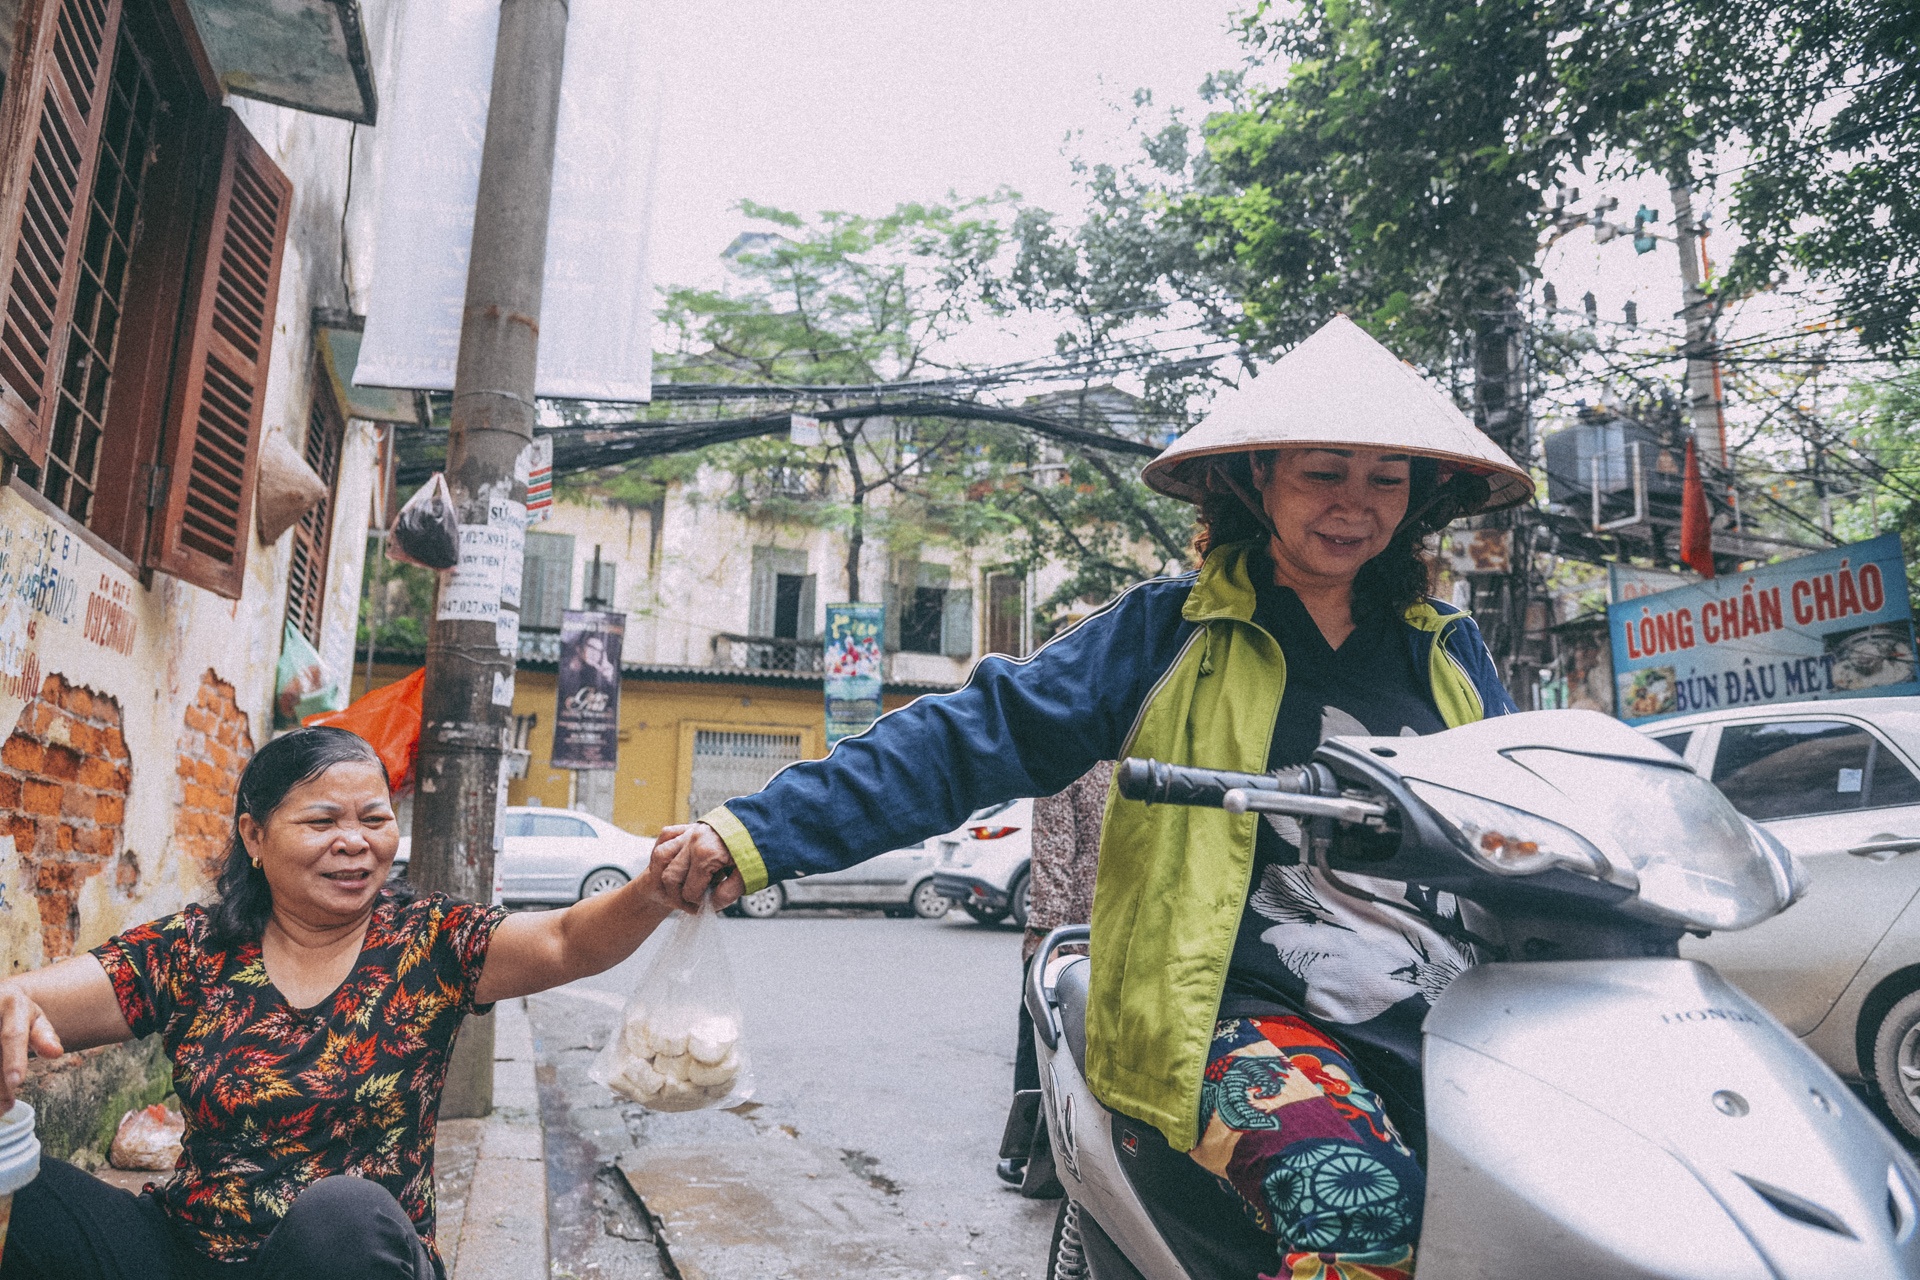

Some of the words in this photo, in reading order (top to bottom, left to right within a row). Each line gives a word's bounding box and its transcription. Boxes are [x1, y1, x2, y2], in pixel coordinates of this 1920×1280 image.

[1625, 606, 1696, 660] LÒNG
[1791, 559, 1885, 626] CHÁO
[1674, 667, 1719, 711] BÚN
[1660, 1007, 1758, 1024] HONDA
